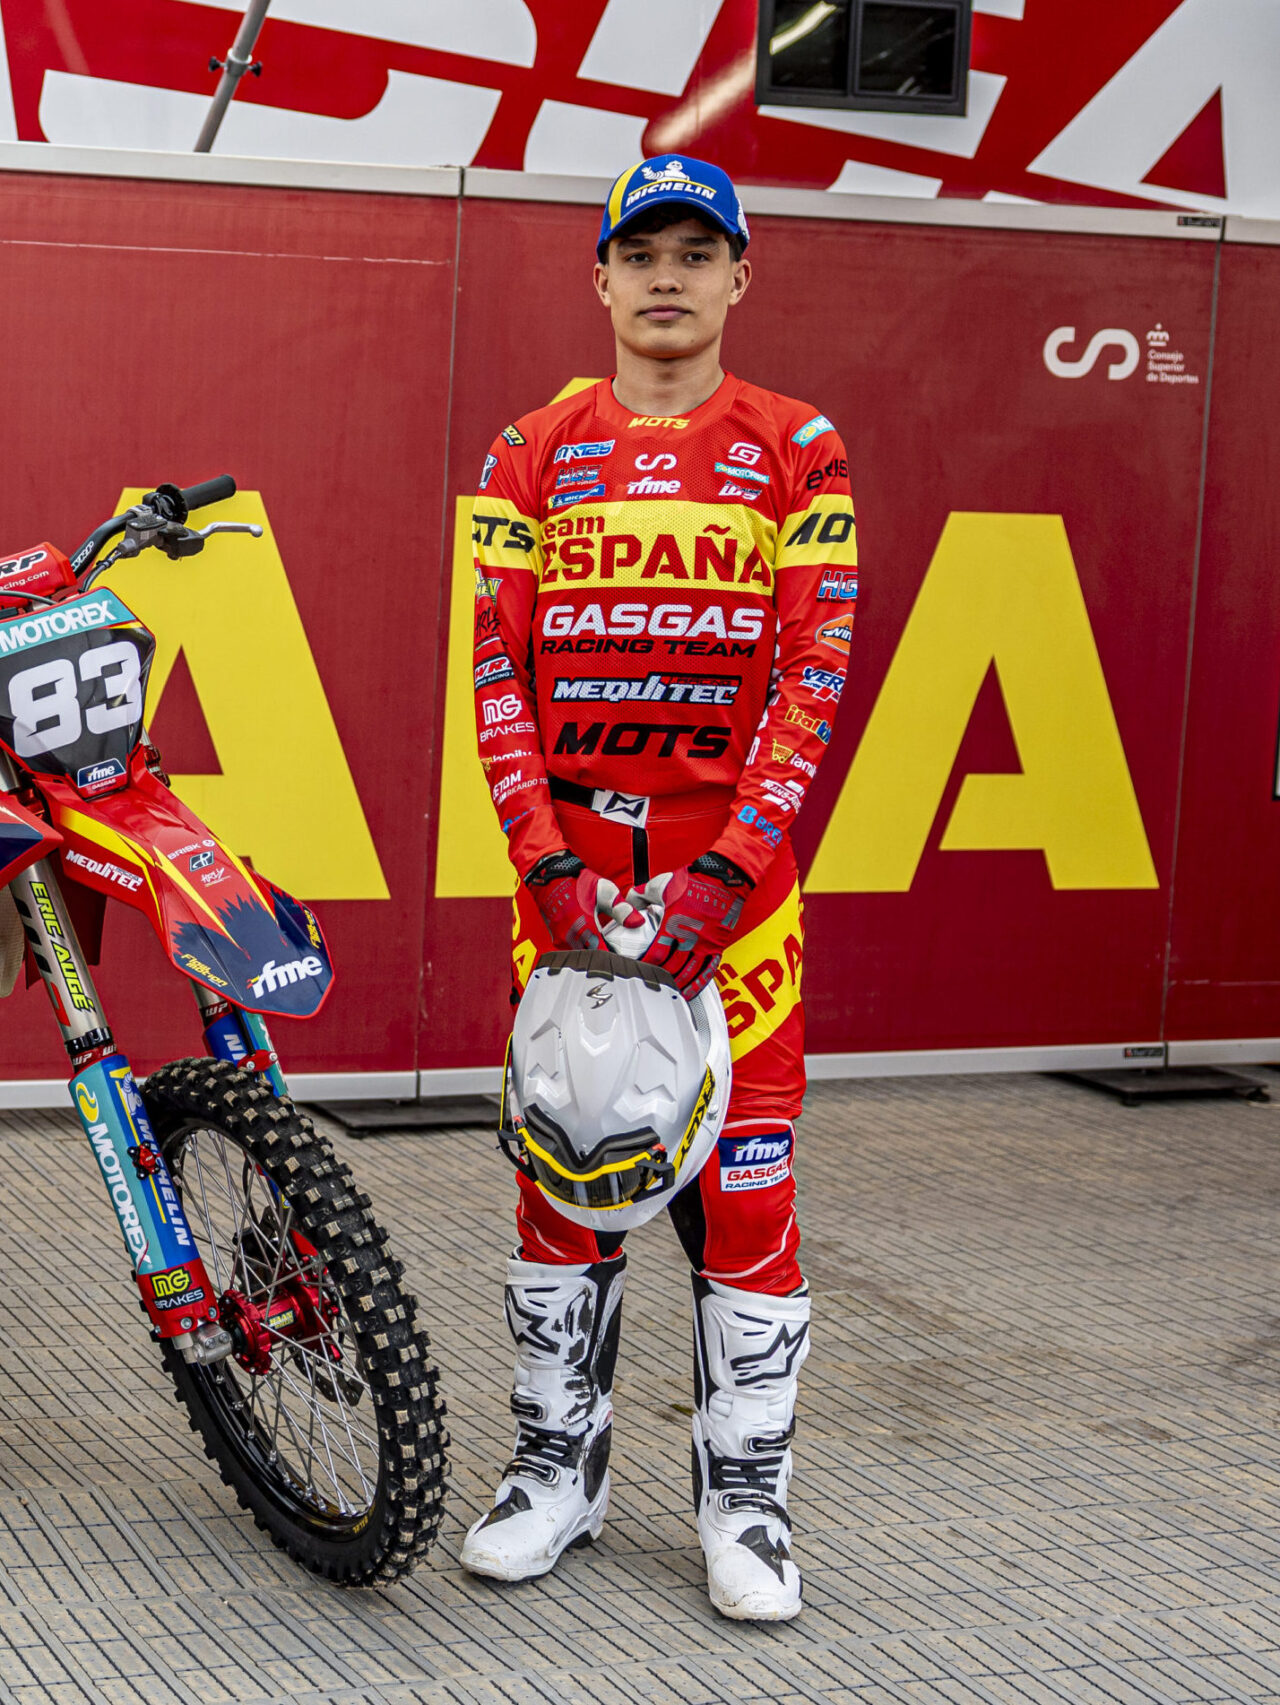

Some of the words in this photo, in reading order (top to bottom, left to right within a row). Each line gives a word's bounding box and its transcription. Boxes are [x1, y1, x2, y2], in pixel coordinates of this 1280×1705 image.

[625, 181, 717, 207] MICHELIN
[1147, 349, 1184, 363] Consejo
[1147, 360, 1185, 372] Superior
[1146, 371, 1158, 382] de
[1159, 371, 1199, 384] Deportes
[627, 416, 691, 429] MOTS
[627, 476, 682, 495] rfme
[541, 516, 606, 542] eam
[541, 524, 772, 587] ESPAÑA
[817, 570, 858, 600] HG
[542, 603, 765, 640] GASGAS
[540, 639, 654, 655] RACING
[664, 640, 756, 658] TEAM
[553, 675, 738, 704] MEQUITEC
[803, 666, 846, 693] VER
[8, 641, 143, 758] 83
[480, 722, 535, 743] BRAKES
[553, 722, 732, 759] MOTS
[87, 765, 116, 782] rfme
[507, 778, 538, 797] RICARDO
[167, 843, 201, 860] BRISK
[65, 849, 143, 892] MEQUITEC
[29, 880, 63, 942] ERIC
[52, 941, 97, 1014] AUGÉ
[249, 956, 323, 998] rfme
[734, 1137, 789, 1162] rfme
[725, 1180, 768, 1190] RACING
[770, 1170, 788, 1184] TEAM
[727, 1157, 788, 1182] GASGAS
[88, 1122, 152, 1270] MOTOREX
[155, 1288, 204, 1310] BRAKES
